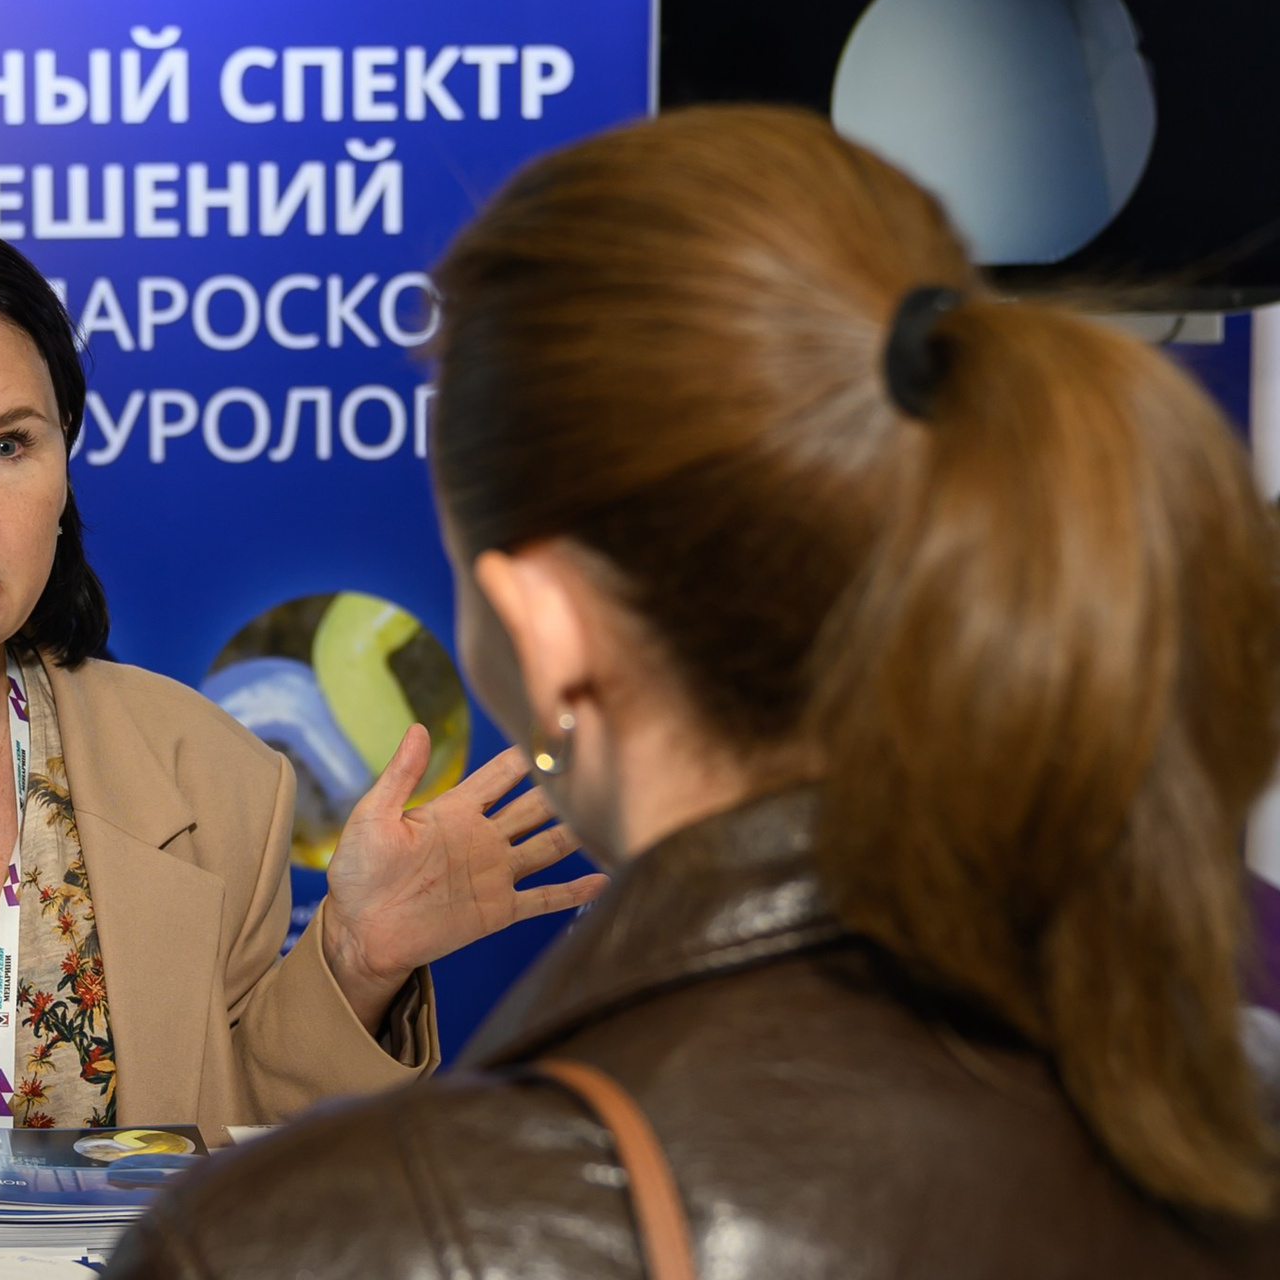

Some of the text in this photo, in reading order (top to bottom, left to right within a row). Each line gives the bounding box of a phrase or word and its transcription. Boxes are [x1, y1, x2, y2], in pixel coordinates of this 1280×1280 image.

[219, 44, 575, 123] СПЕКТР
[48, 272, 444, 353] АРОСКО
[70, 384, 439, 467] УРОЛОГ
[3, 955, 12, 1002] МЕНАРИНИ
